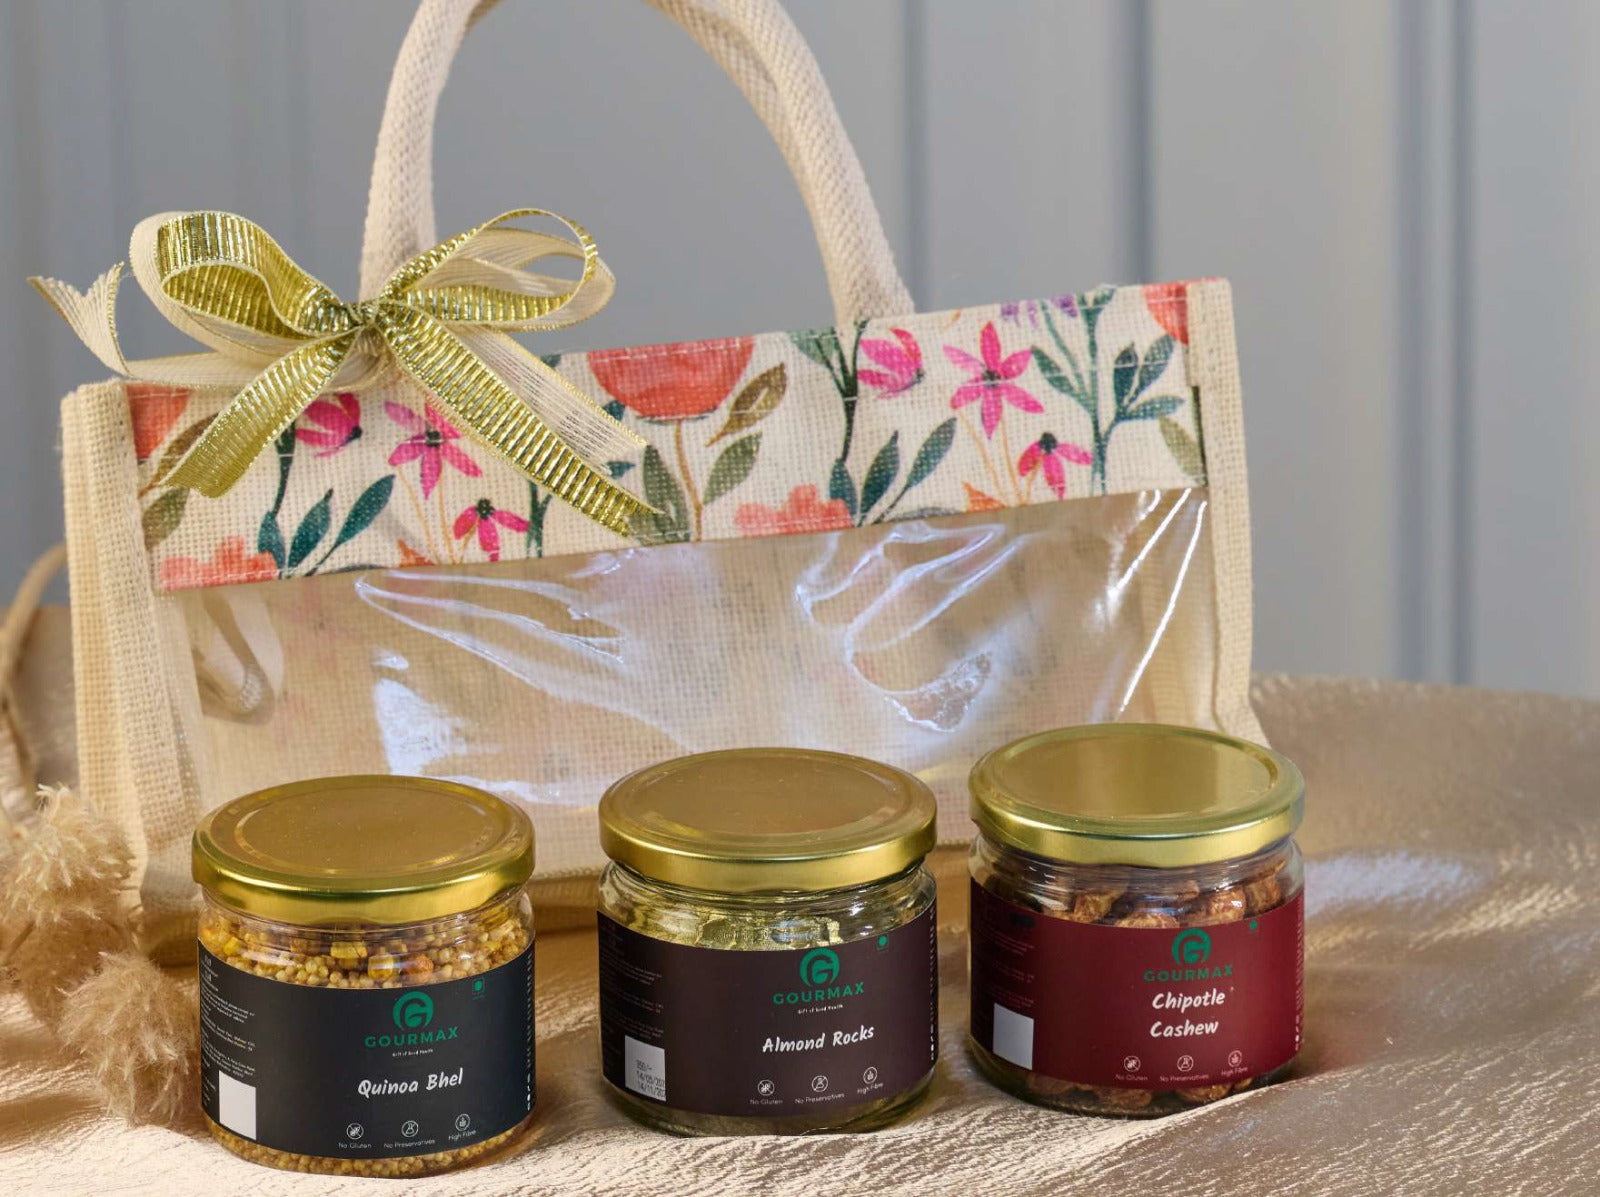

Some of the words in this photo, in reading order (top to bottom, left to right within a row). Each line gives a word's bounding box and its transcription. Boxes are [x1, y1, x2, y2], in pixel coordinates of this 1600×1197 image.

[1143, 964, 1234, 983] GOURMAX
[772, 982, 864, 1005] GOURMAX
[1152, 988, 1225, 1013] Chipotle
[365, 1026, 459, 1048] GOURMAX
[762, 1033, 825, 1053] Almond
[832, 1025, 874, 1046] Rocks
[1150, 1019, 1219, 1038] Cashew
[357, 1079, 419, 1099] Quinoa
[426, 1067, 463, 1091] Bhel
